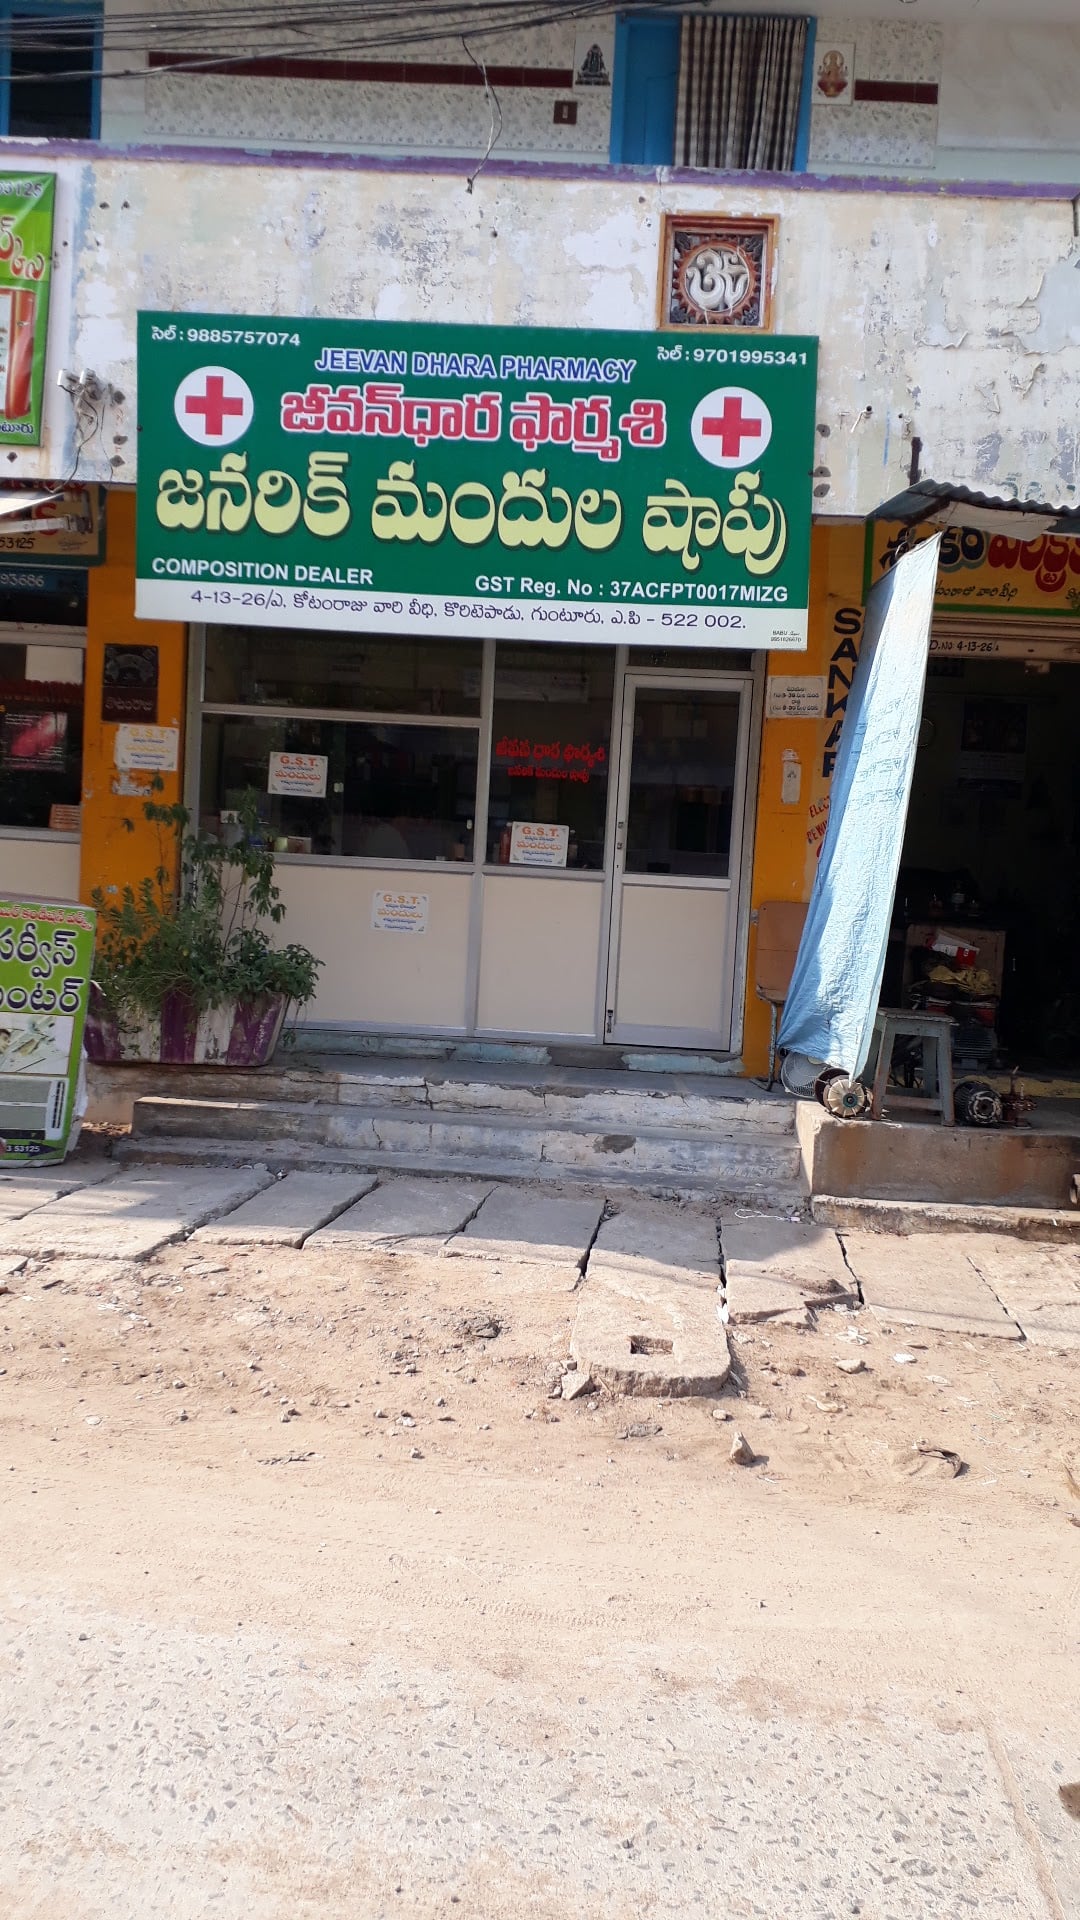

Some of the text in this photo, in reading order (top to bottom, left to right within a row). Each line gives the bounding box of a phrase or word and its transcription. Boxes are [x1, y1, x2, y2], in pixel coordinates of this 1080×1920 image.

[187, 328, 300, 346] 9885757074
[315, 348, 637, 382] JEEVAN DHARA PHARMACY
[693, 348, 807, 365] 9701995341
[511, 391, 667, 462] ఫార్మశి
[156, 451, 786, 575] జనరిక్ మందుల షాపు
[151, 557, 373, 585] COMPOSITION DEALER
[475, 575, 515, 592] GST
[520, 577, 561, 598] Reg.
[567, 579, 592, 595] No
[610, 581, 788, 602] 37ACFPT0017MIZG
[373, 601, 403, 614] వారి
[661, 613, 698, 627] 522
[704, 614, 746, 629] 002.
